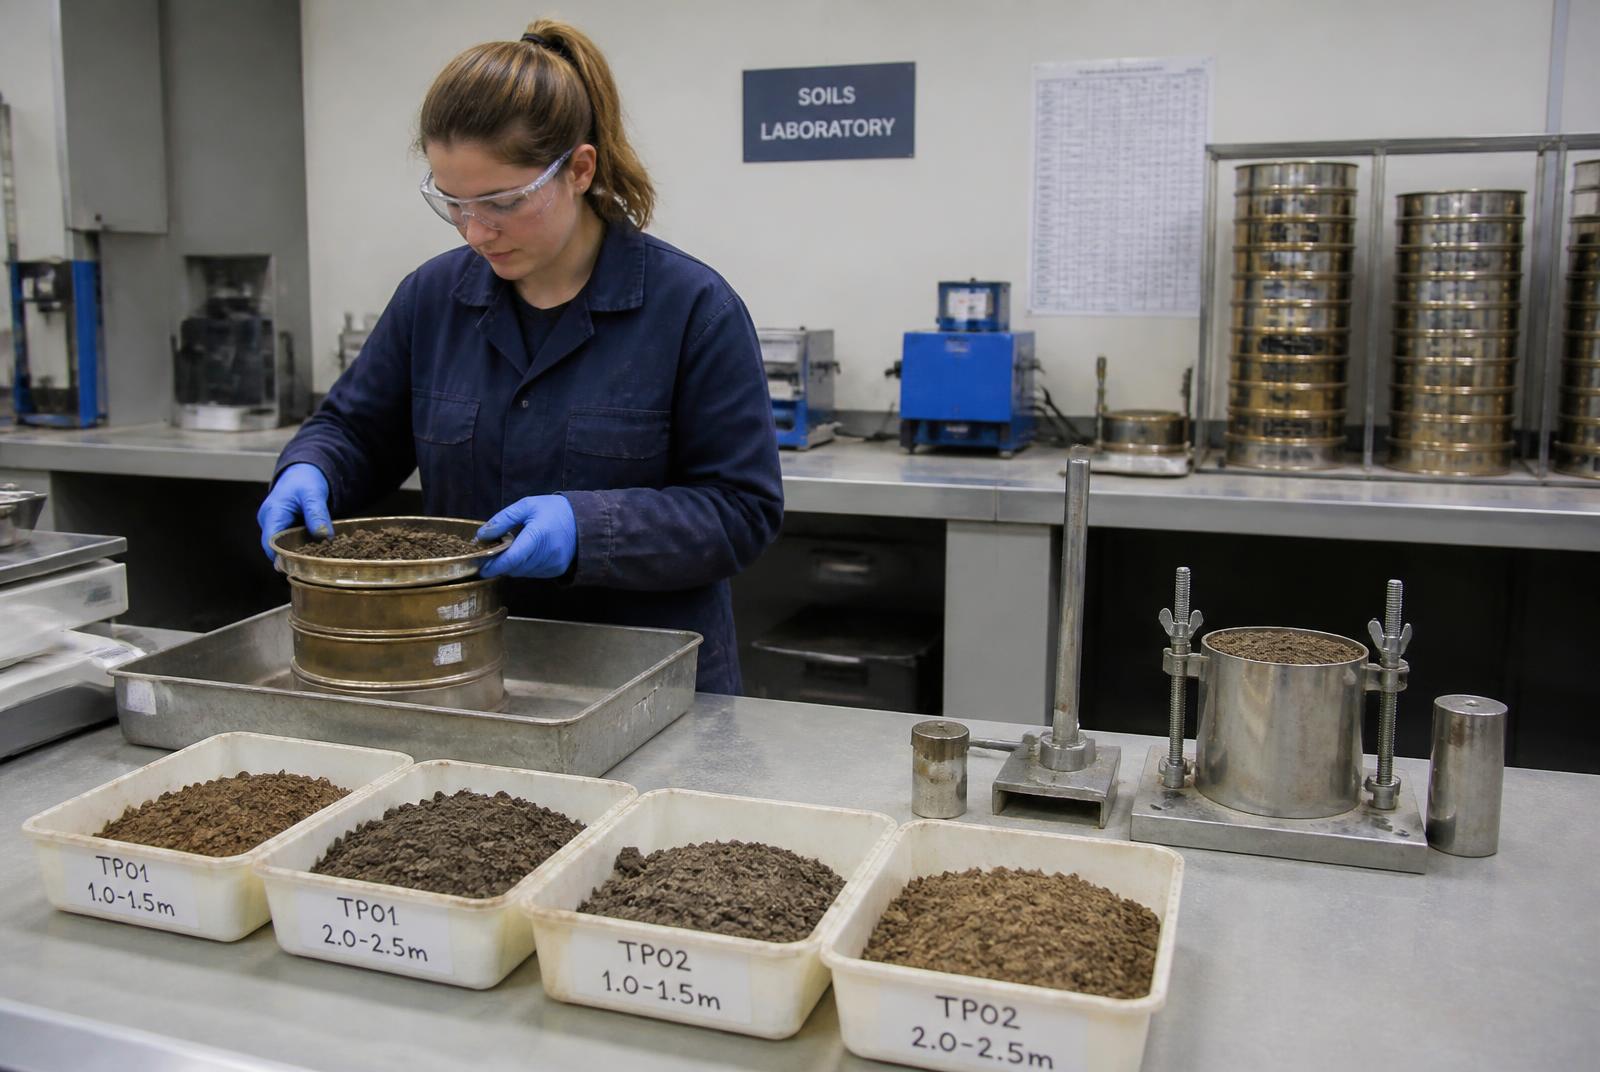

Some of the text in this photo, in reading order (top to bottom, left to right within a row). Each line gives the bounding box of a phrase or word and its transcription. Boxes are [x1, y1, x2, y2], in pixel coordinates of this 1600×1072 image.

[799, 86, 855, 105] SOILS
[761, 118, 895, 140] LABORATORY
[87, 882, 175, 918] 1.0-1.5m
[322, 924, 428, 963] 2.0-2.5m
[602, 970, 721, 1011] 1.0-1.5m
[911, 1026, 1054, 1071] 2.0-2.5m
